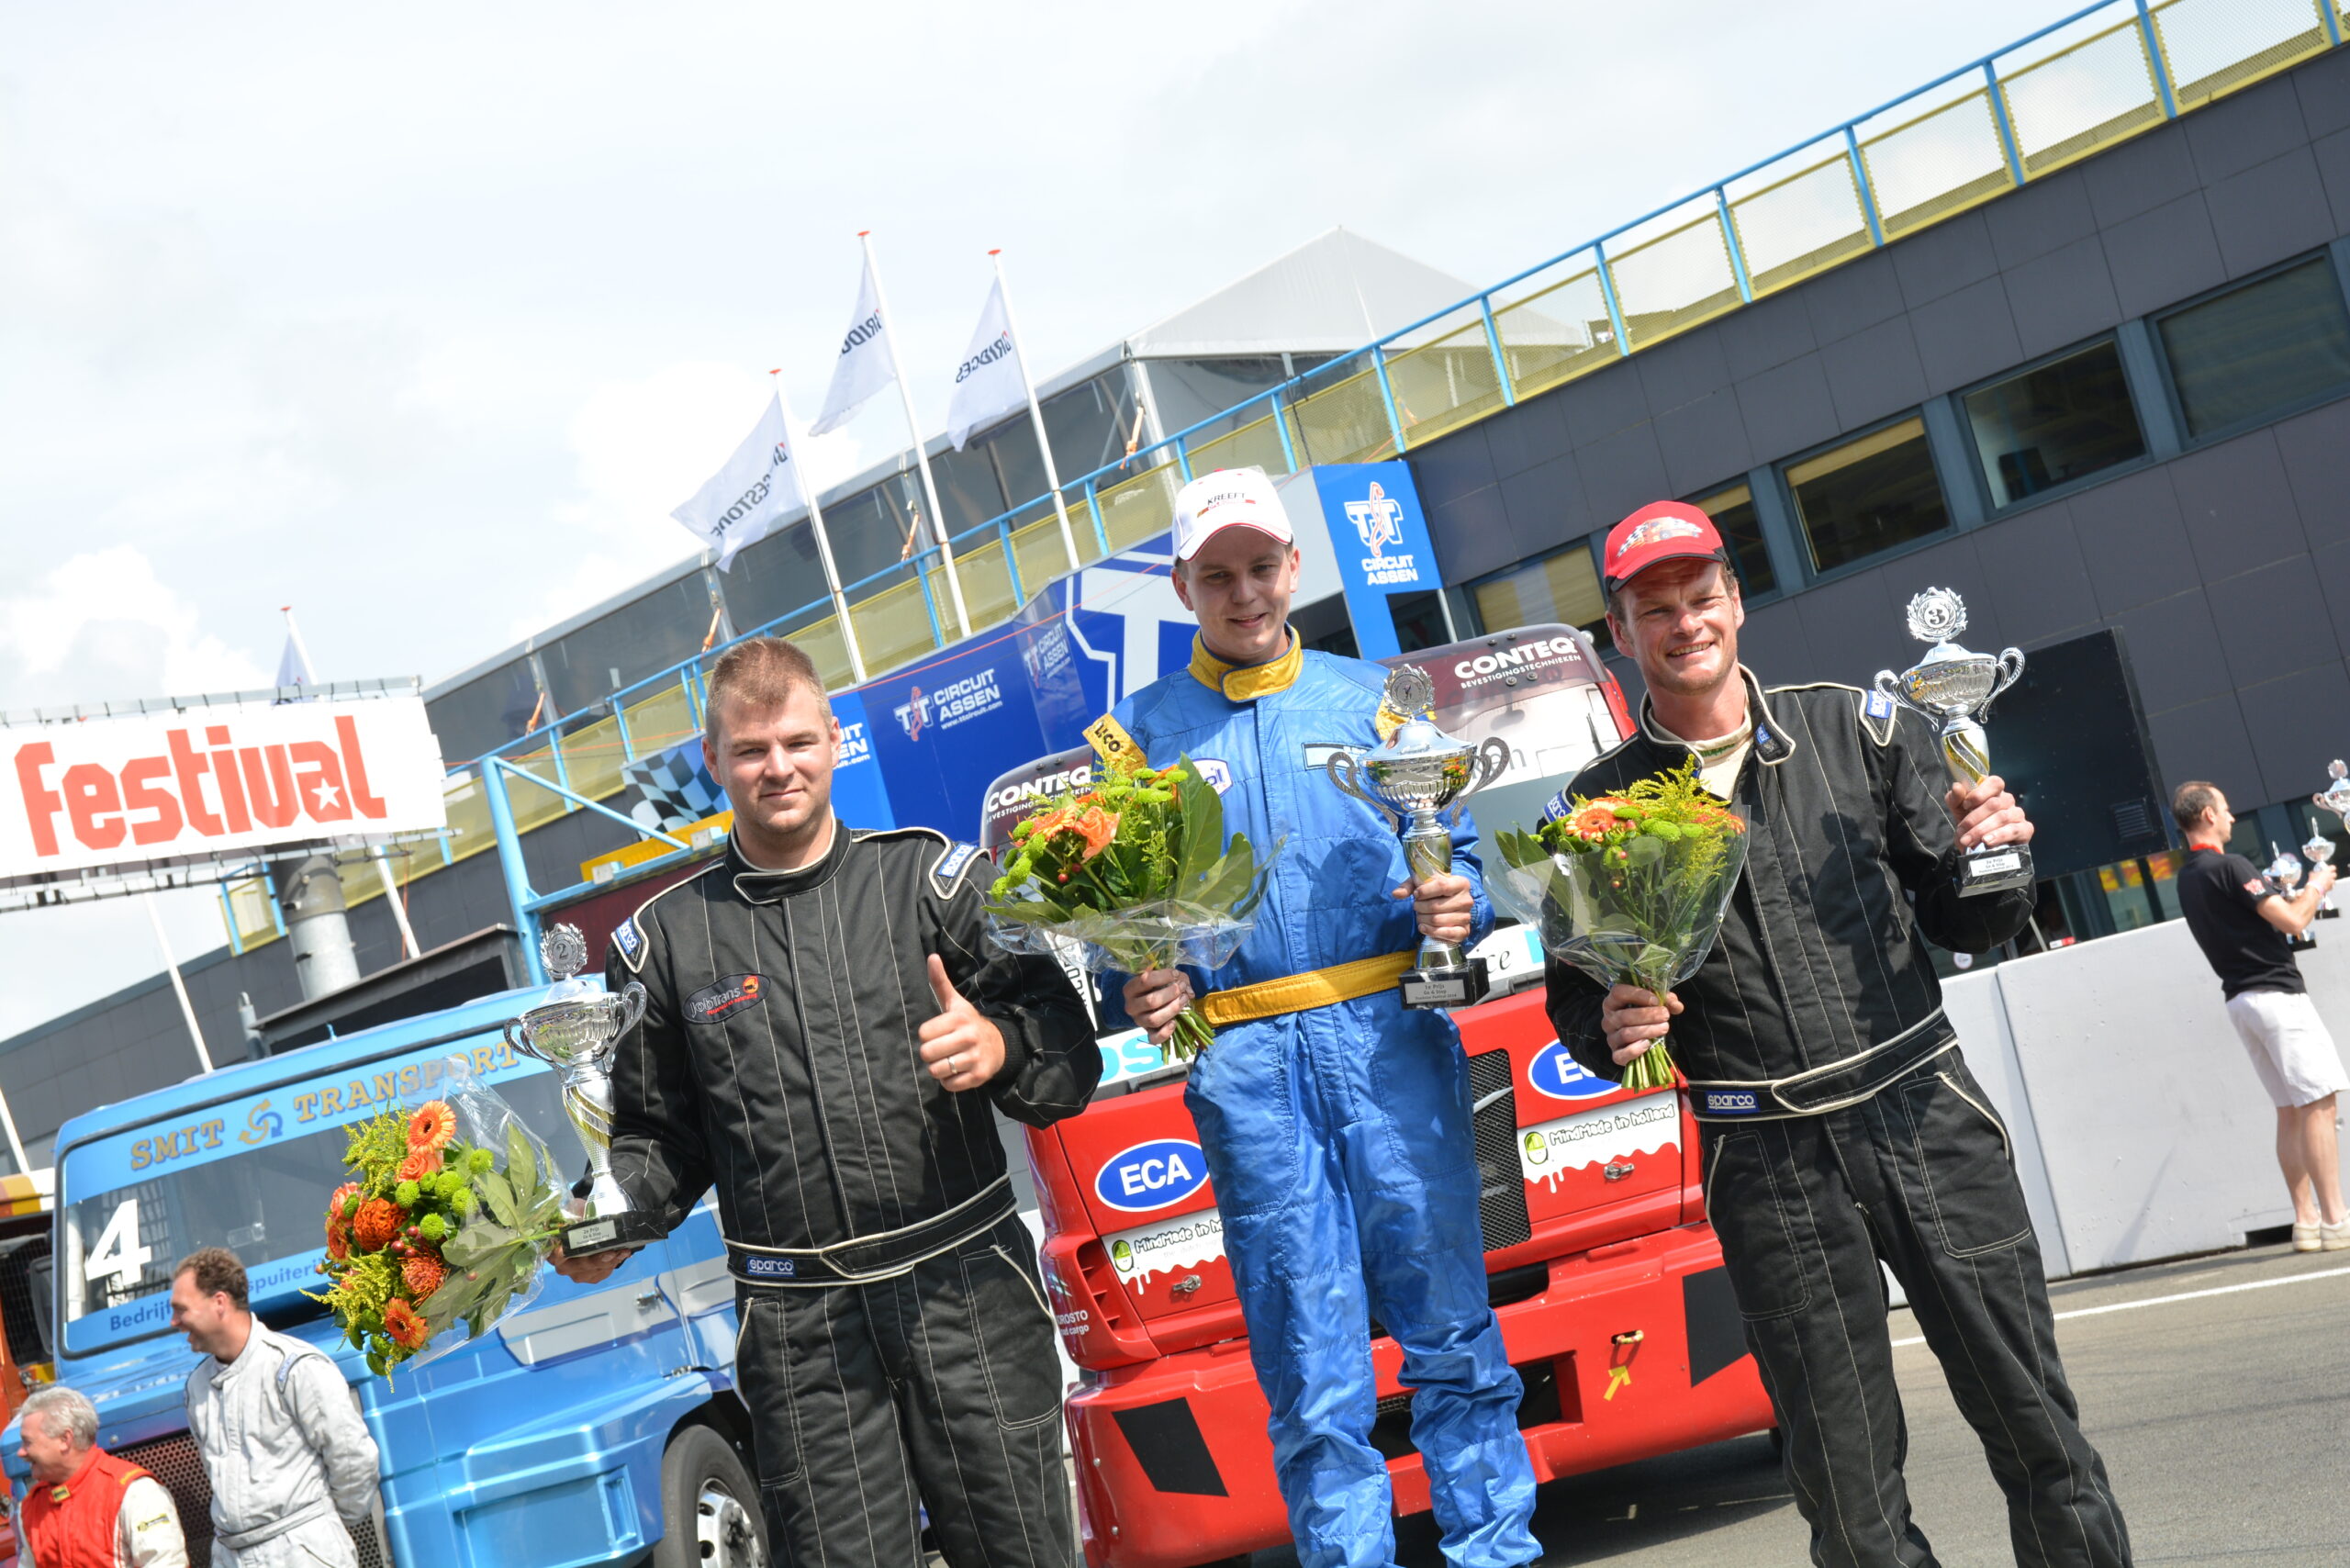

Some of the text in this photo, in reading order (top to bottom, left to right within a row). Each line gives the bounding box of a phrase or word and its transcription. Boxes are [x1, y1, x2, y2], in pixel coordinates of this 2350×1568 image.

[1361, 554, 1414, 572] CIRCUIT
[1367, 567, 1419, 586] ASSEN
[1929, 609, 1946, 625] 3
[1455, 636, 1578, 678] CONTEQ
[1460, 655, 1582, 689] BEVESTIGINGSTECHNIEKEN
[933, 667, 995, 706] CIRCUIT
[939, 684, 1002, 722] ASSEN
[556, 944, 569, 959] 2
[690, 988, 741, 1019] JobTrans
[130, 1039, 521, 1171] SMIT TRANSPORT
[1707, 1094, 1756, 1110] sparco
[1549, 1103, 1675, 1147] MindMade in holland
[1119, 1153, 1192, 1196] ECA
[84, 1198, 152, 1287] 4
[1135, 1227, 1193, 1255] MindMade
[1195, 1223, 1210, 1237] in
[749, 1259, 794, 1274] sparco
